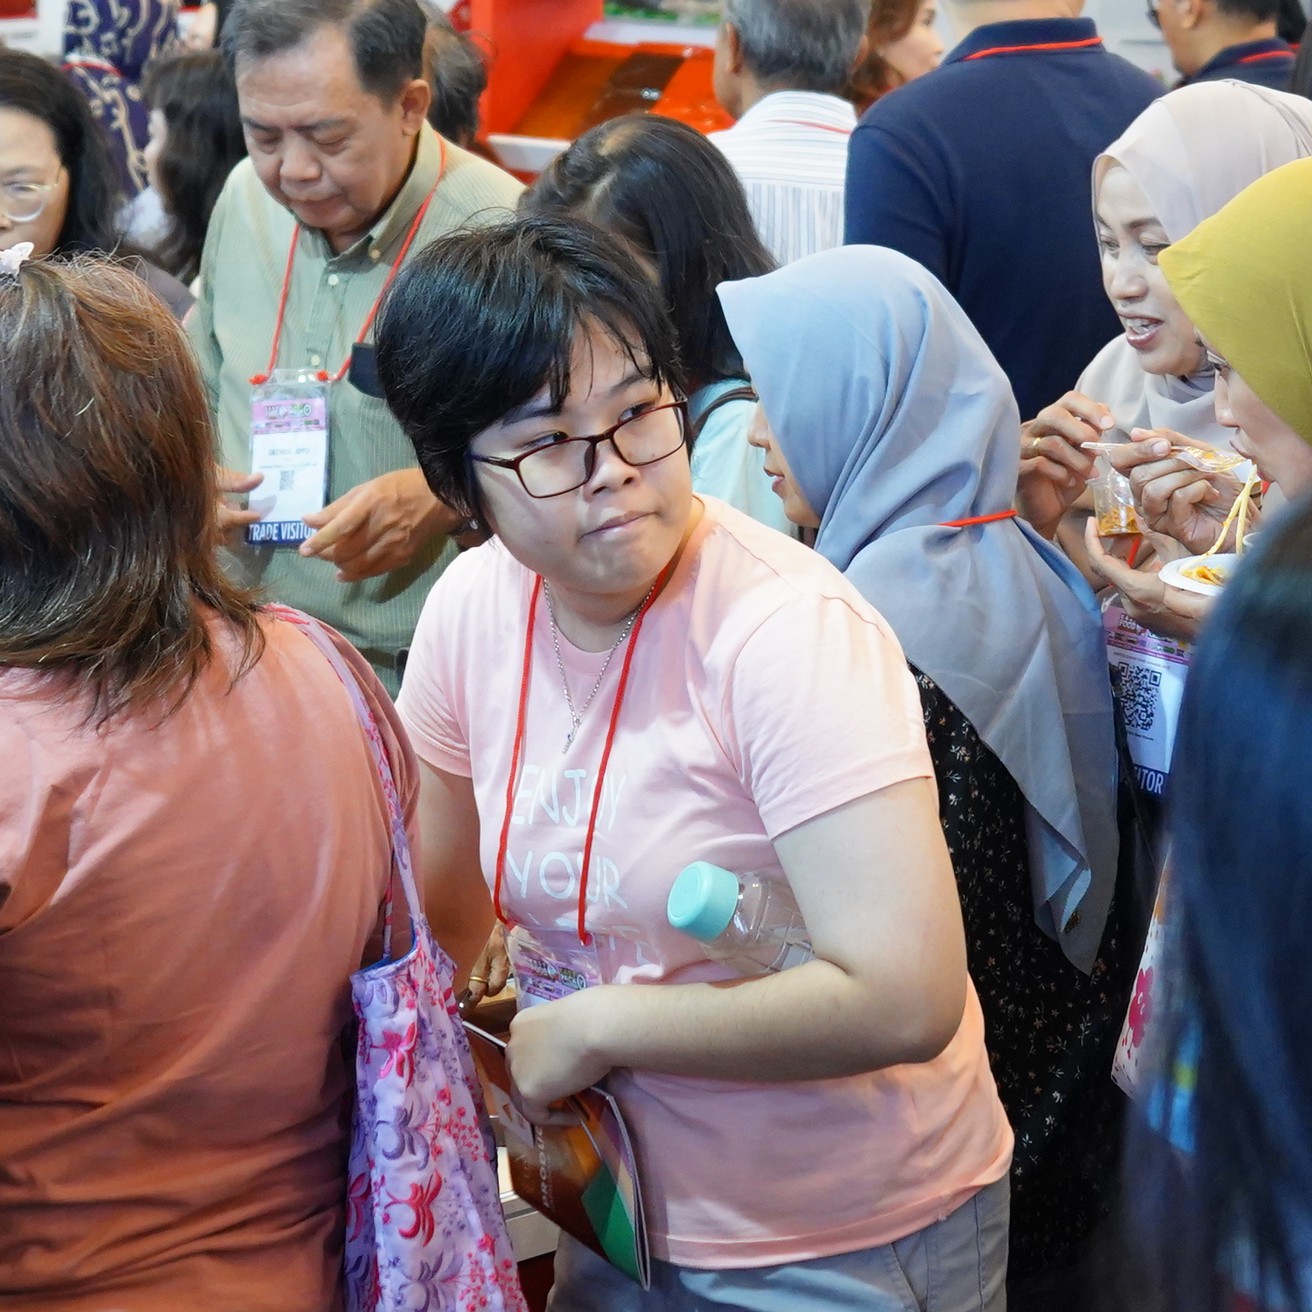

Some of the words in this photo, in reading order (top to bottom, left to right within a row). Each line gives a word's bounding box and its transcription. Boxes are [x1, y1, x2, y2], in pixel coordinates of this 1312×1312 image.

[249, 523, 278, 541] TRADE
[280, 521, 317, 540] VISITO
[511, 764, 626, 831] ENJOY
[506, 850, 628, 909] YOUR
[537, 1126, 550, 1208] PRODUC
